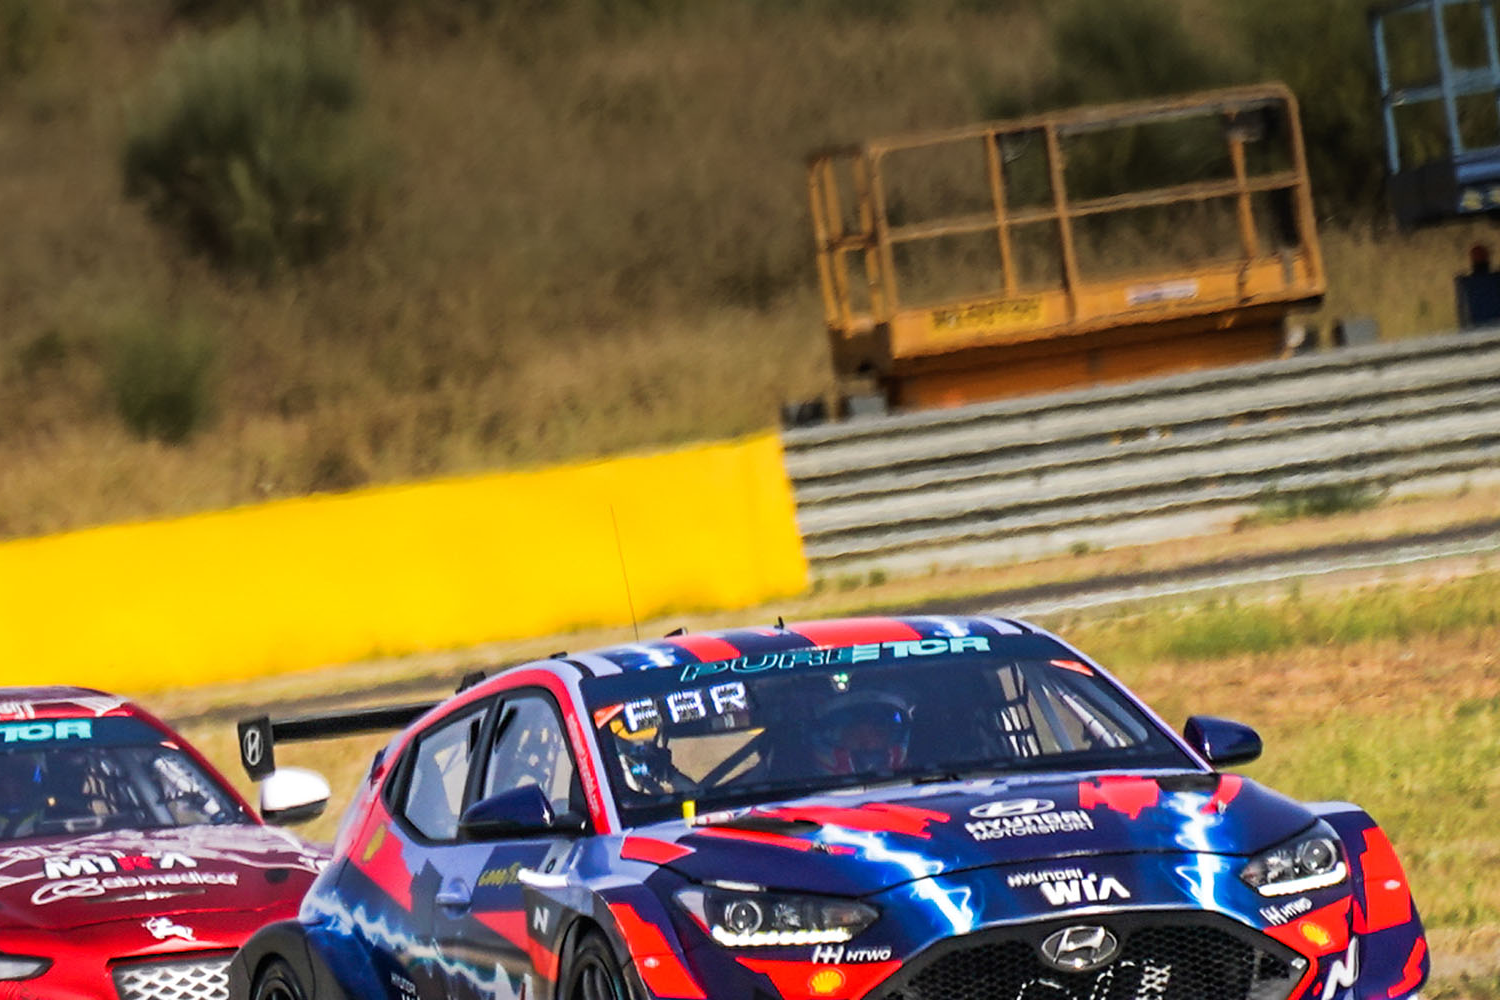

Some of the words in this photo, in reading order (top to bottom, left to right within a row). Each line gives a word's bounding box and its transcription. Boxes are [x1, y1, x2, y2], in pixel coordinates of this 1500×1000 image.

[624, 681, 748, 732] FAR
[965, 810, 1095, 836] HYUNDAI
[1007, 868, 1084, 888] HYUNDAI
[1040, 873, 1132, 906] WIA
[846, 947, 892, 963] HTWO
